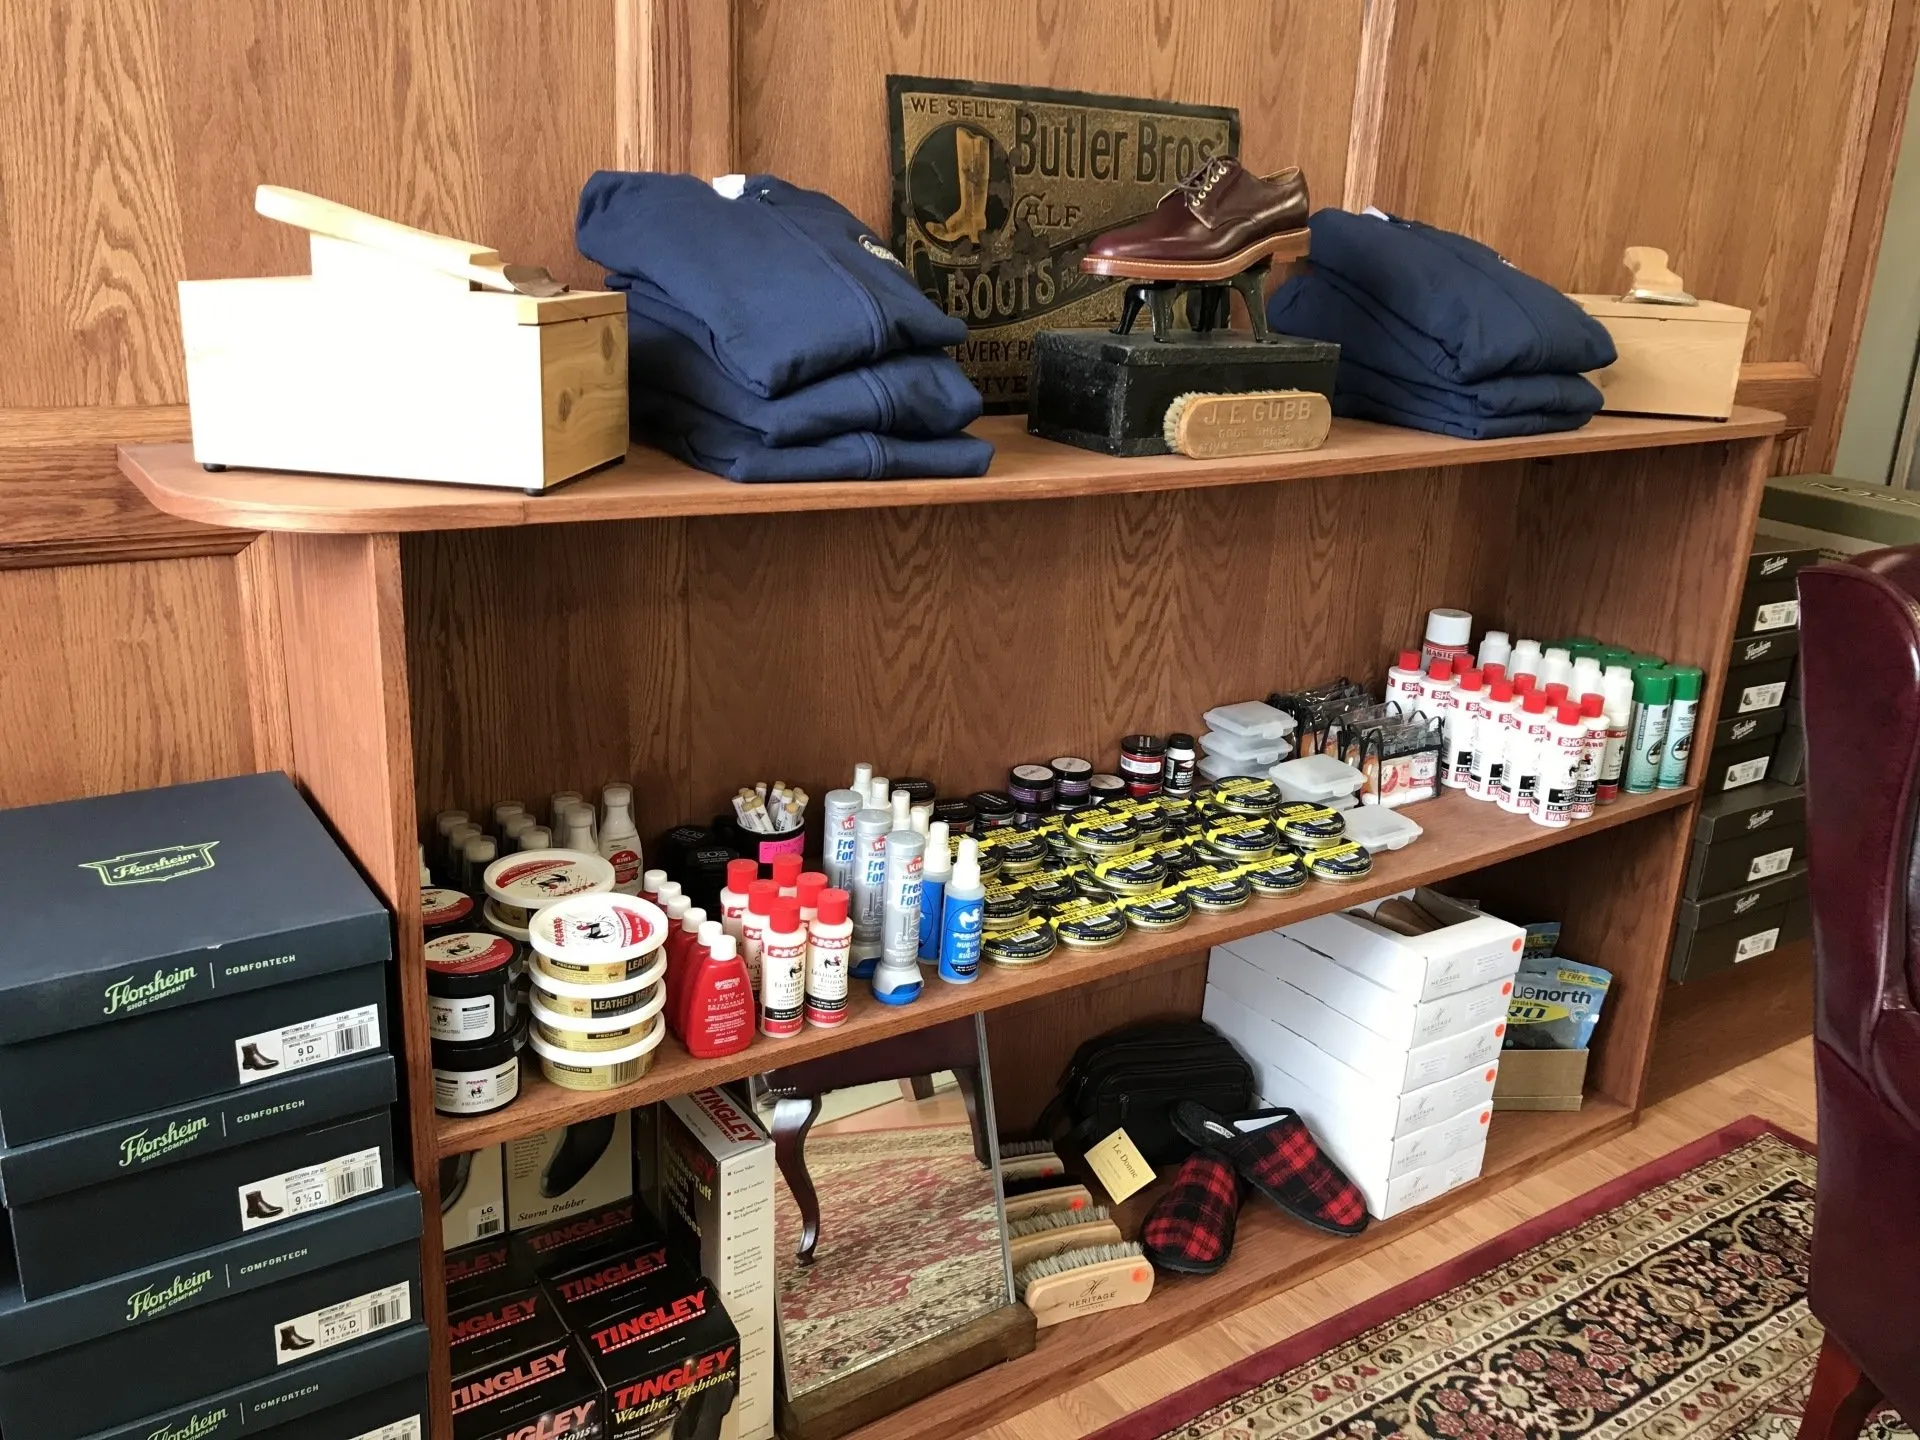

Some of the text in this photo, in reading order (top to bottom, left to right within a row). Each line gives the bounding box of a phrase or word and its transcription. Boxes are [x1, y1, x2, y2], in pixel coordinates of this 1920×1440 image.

[911, 97, 997, 119] WE SELL
[1013, 107, 1129, 181] Butler
[1014, 192, 1081, 236] CALF
[956, 340, 1014, 363] EVERY
[1229, 402, 1246, 425] E.
[1252, 399, 1312, 422] GUBB
[1426, 648, 1454, 659] MASTE
[113, 852, 199, 879] Florsheim
[225, 954, 297, 976] COMFORTECH
[103, 965, 198, 1015] Florsheim
[127, 983, 187, 1012] SHOE COMPANY
[593, 994, 634, 1011] LEATHER
[1512, 985, 1592, 1004] uenorth
[298, 1045, 314, 1057] 9 D
[236, 1099, 306, 1124] COMFORTECH
[118, 1116, 210, 1167] Florsheim
[141, 1132, 200, 1164] SHOE COMPANY
[1112, 1143, 1139, 1179] Le Donne
[295, 1196, 301, 1206] 9
[314, 1190, 322, 1200] D
[481, 1206, 494, 1215] LG
[517, 1198, 587, 1222] Storm Rubber
[528, 1204, 633, 1250] TINGLEY
[239, 1248, 308, 1275] COMFORTECH
[557, 1246, 668, 1298] TINGLEY
[126, 1269, 214, 1321] Florsheim
[147, 1285, 204, 1317] SHOE COMPANY
[1068, 1291, 1117, 1308] HERITAGE
[325, 1326, 335, 1337] 11
[349, 1319, 356, 1329] D
[449, 1295, 538, 1340] NGLEY
[591, 1289, 706, 1349] TINGLEY
[451, 1348, 567, 1409] TINGLEY
[614, 1346, 735, 1412] TINGLEY
[254, 1383, 319, 1412] COMFORTECH
[614, 1370, 733, 1425] Weather Fashions
[623, 1427, 639, 1437] Finest
